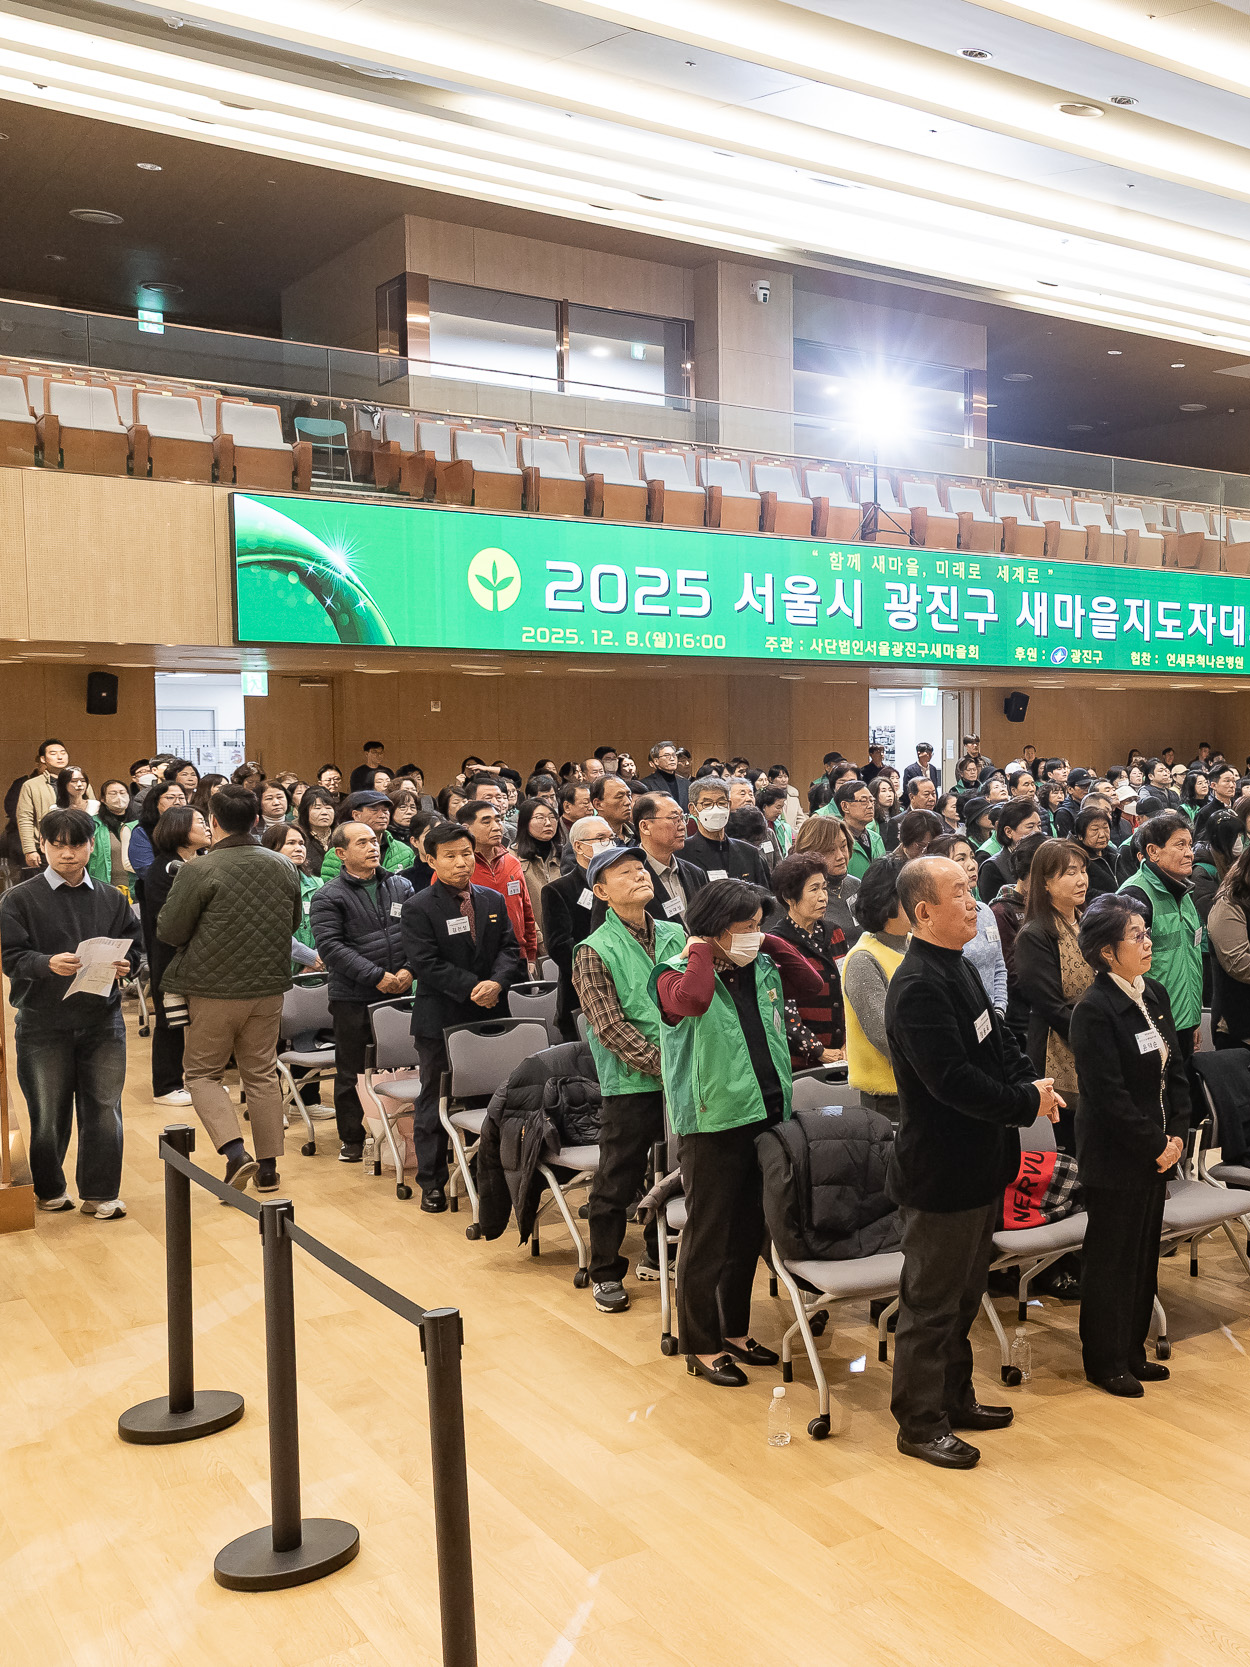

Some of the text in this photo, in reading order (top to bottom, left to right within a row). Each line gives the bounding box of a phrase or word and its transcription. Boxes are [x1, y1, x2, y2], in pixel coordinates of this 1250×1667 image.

[829, 551, 861, 573] 함께
[871, 555, 927, 578] 새마을,
[935, 560, 982, 580] 미래로
[996, 565, 1040, 585] 세계로
[545, 560, 712, 619] 2025
[734, 572, 863, 630] 서울시
[883, 581, 1000, 636] 광진구
[521, 626, 585, 646] 2025.
[592, 629, 619, 647] 12.
[764, 636, 794, 653] 주관
[809, 638, 979, 660] 사단법인서울광진구새마을회
[1070, 648, 1104, 665] 광진구
[1166, 653, 1244, 670] 연세무척나은병원
